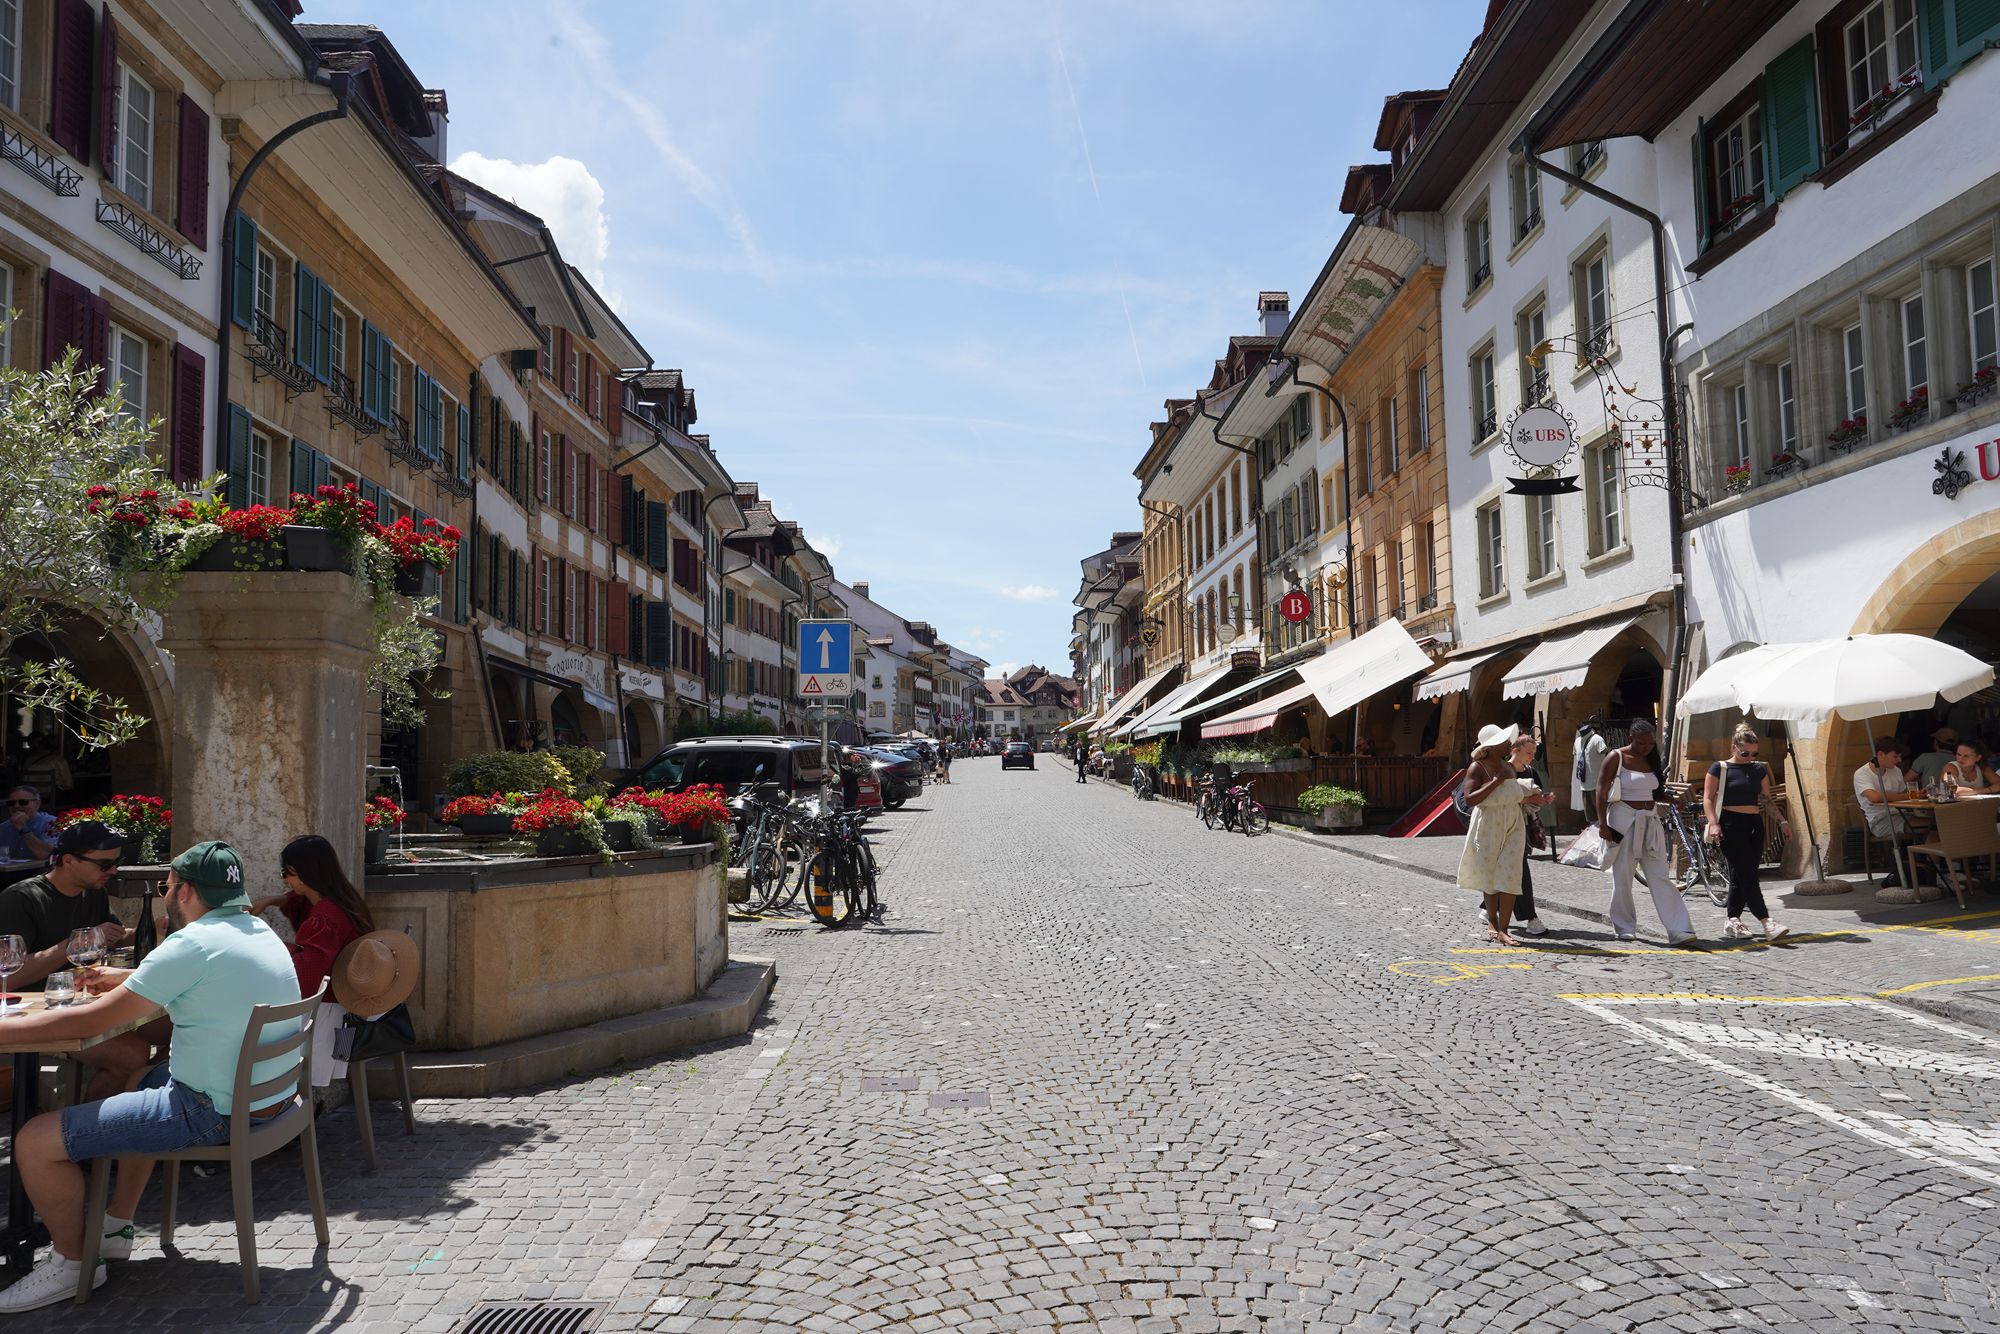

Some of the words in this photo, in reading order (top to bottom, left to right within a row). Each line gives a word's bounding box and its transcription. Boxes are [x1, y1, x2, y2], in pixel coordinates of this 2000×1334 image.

[1535, 428, 1566, 442] UBS
[1290, 598, 1303, 615] B
[551, 658, 584, 675] roguerie
[226, 864, 241, 884] NY
